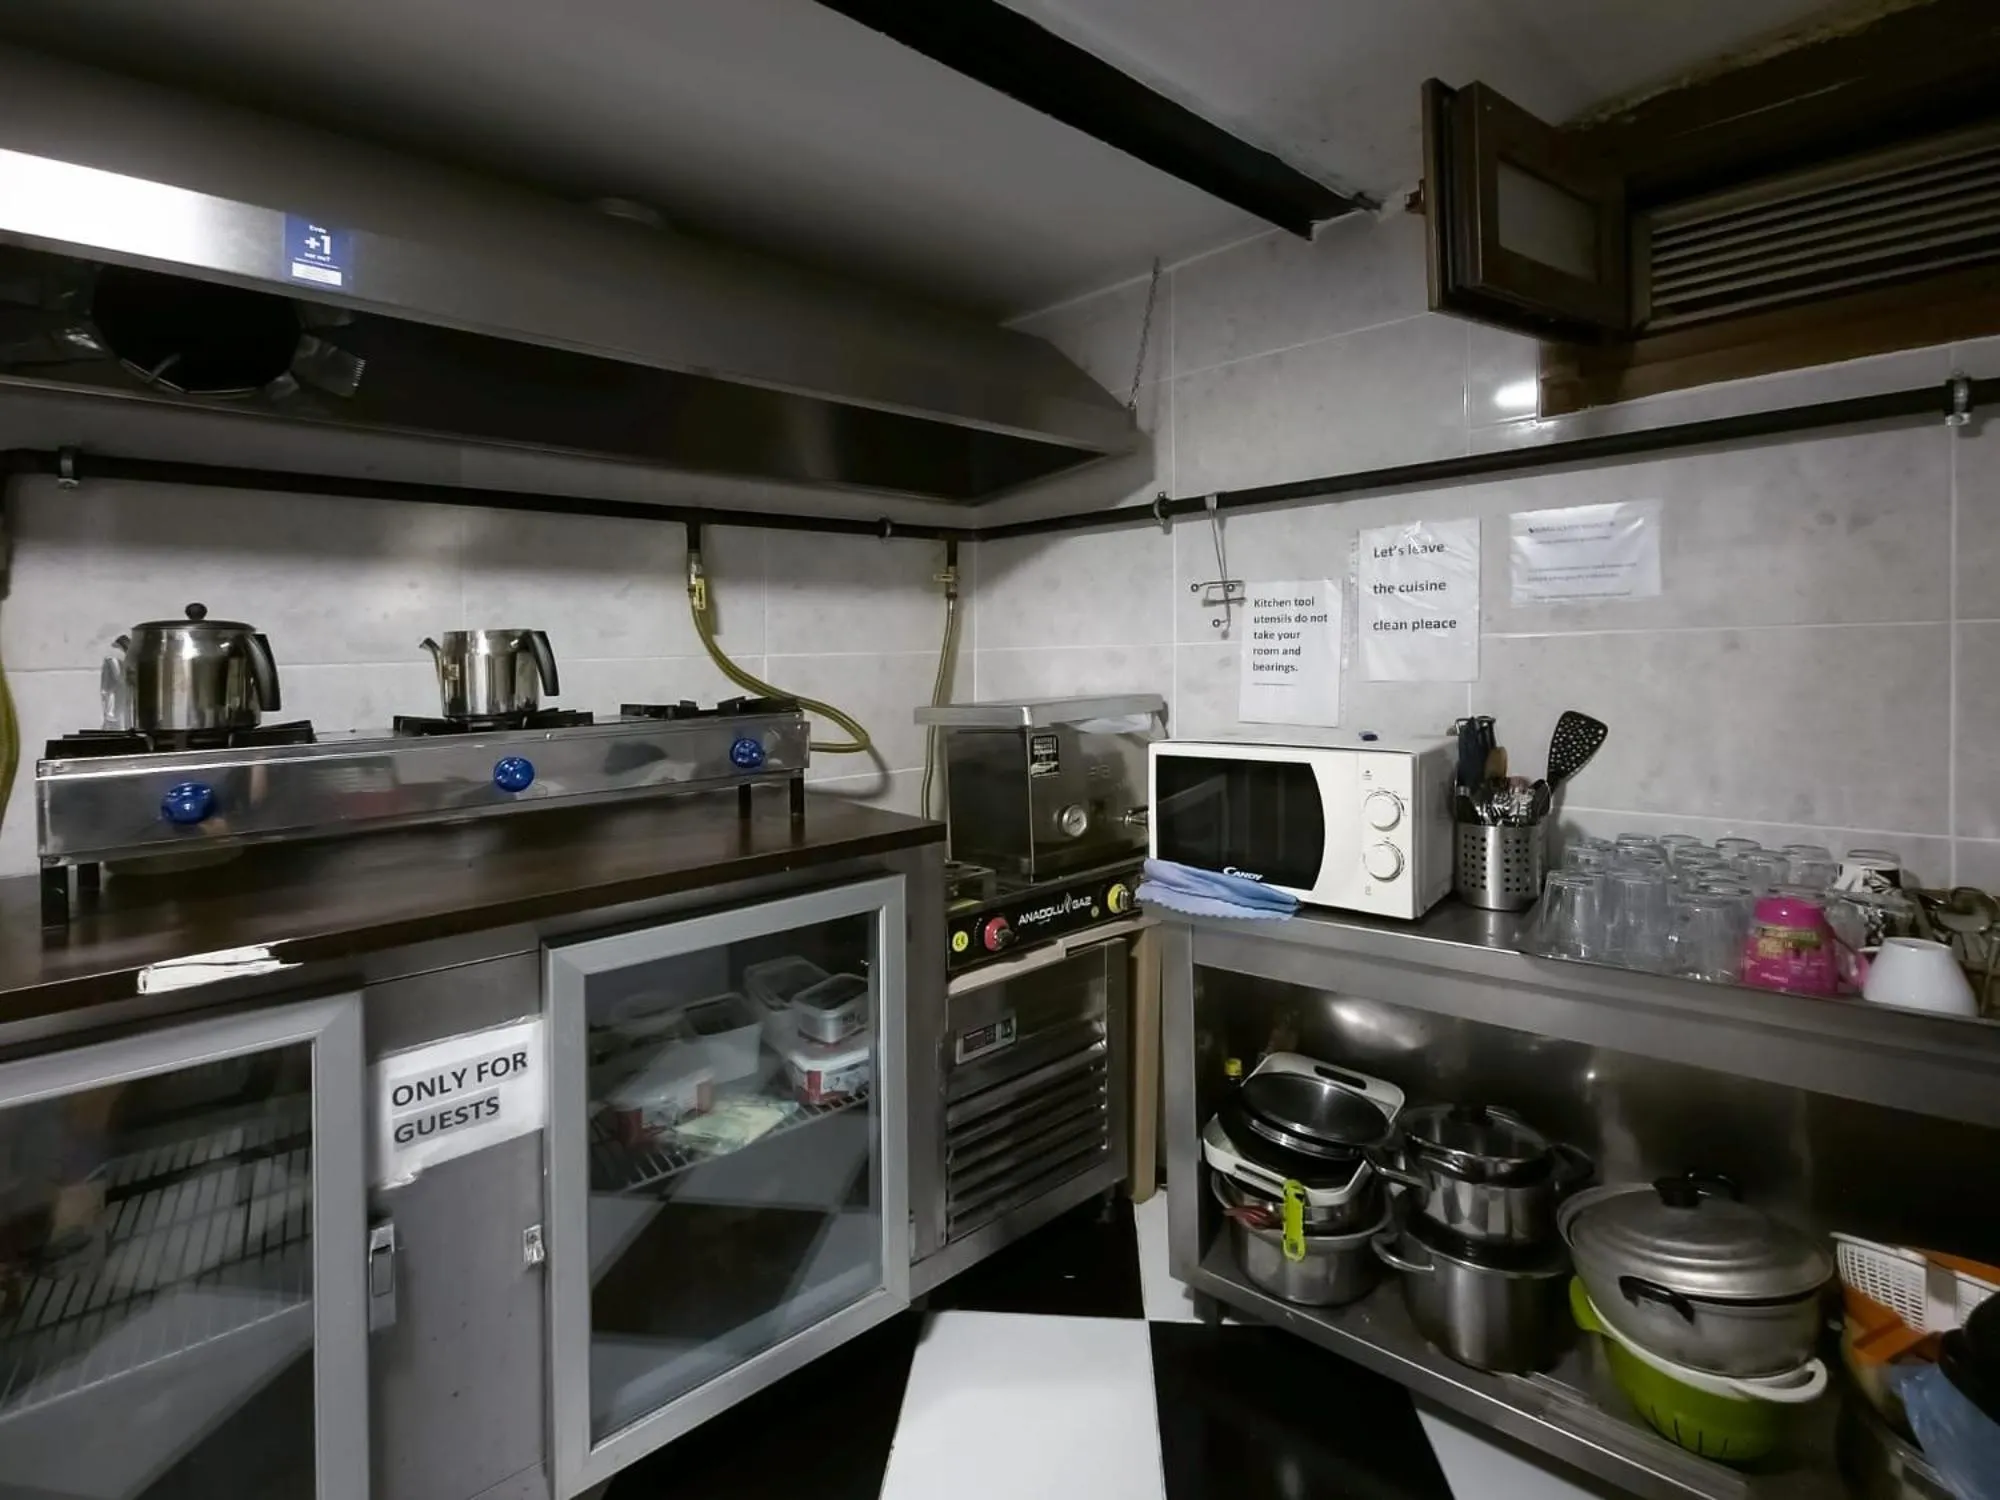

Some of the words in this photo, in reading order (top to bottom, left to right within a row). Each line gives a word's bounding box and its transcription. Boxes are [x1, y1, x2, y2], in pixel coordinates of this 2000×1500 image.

[304, 235, 331, 255] +1
[1373, 545, 1404, 559] Let's
[1373, 583, 1395, 594] the
[1398, 580, 1447, 593] cuisine
[1254, 598, 1292, 608] Kitchen
[1294, 596, 1315, 607] tool
[1253, 614, 1292, 624] utensils
[1294, 613, 1308, 623] do
[1310, 614, 1328, 623] not
[1372, 620, 1408, 631] clean
[1411, 618, 1457, 632] pleace
[1253, 630, 1275, 640] take
[1277, 632, 1301, 641] your
[1282, 646, 1301, 656] and
[1252, 661, 1299, 674] bearings.
[1018, 905, 1064, 926] ANADOLU
[392, 1068, 467, 1107] ONLY
[476, 1051, 528, 1083] FOR
[393, 1096, 500, 1144] GUESTS
